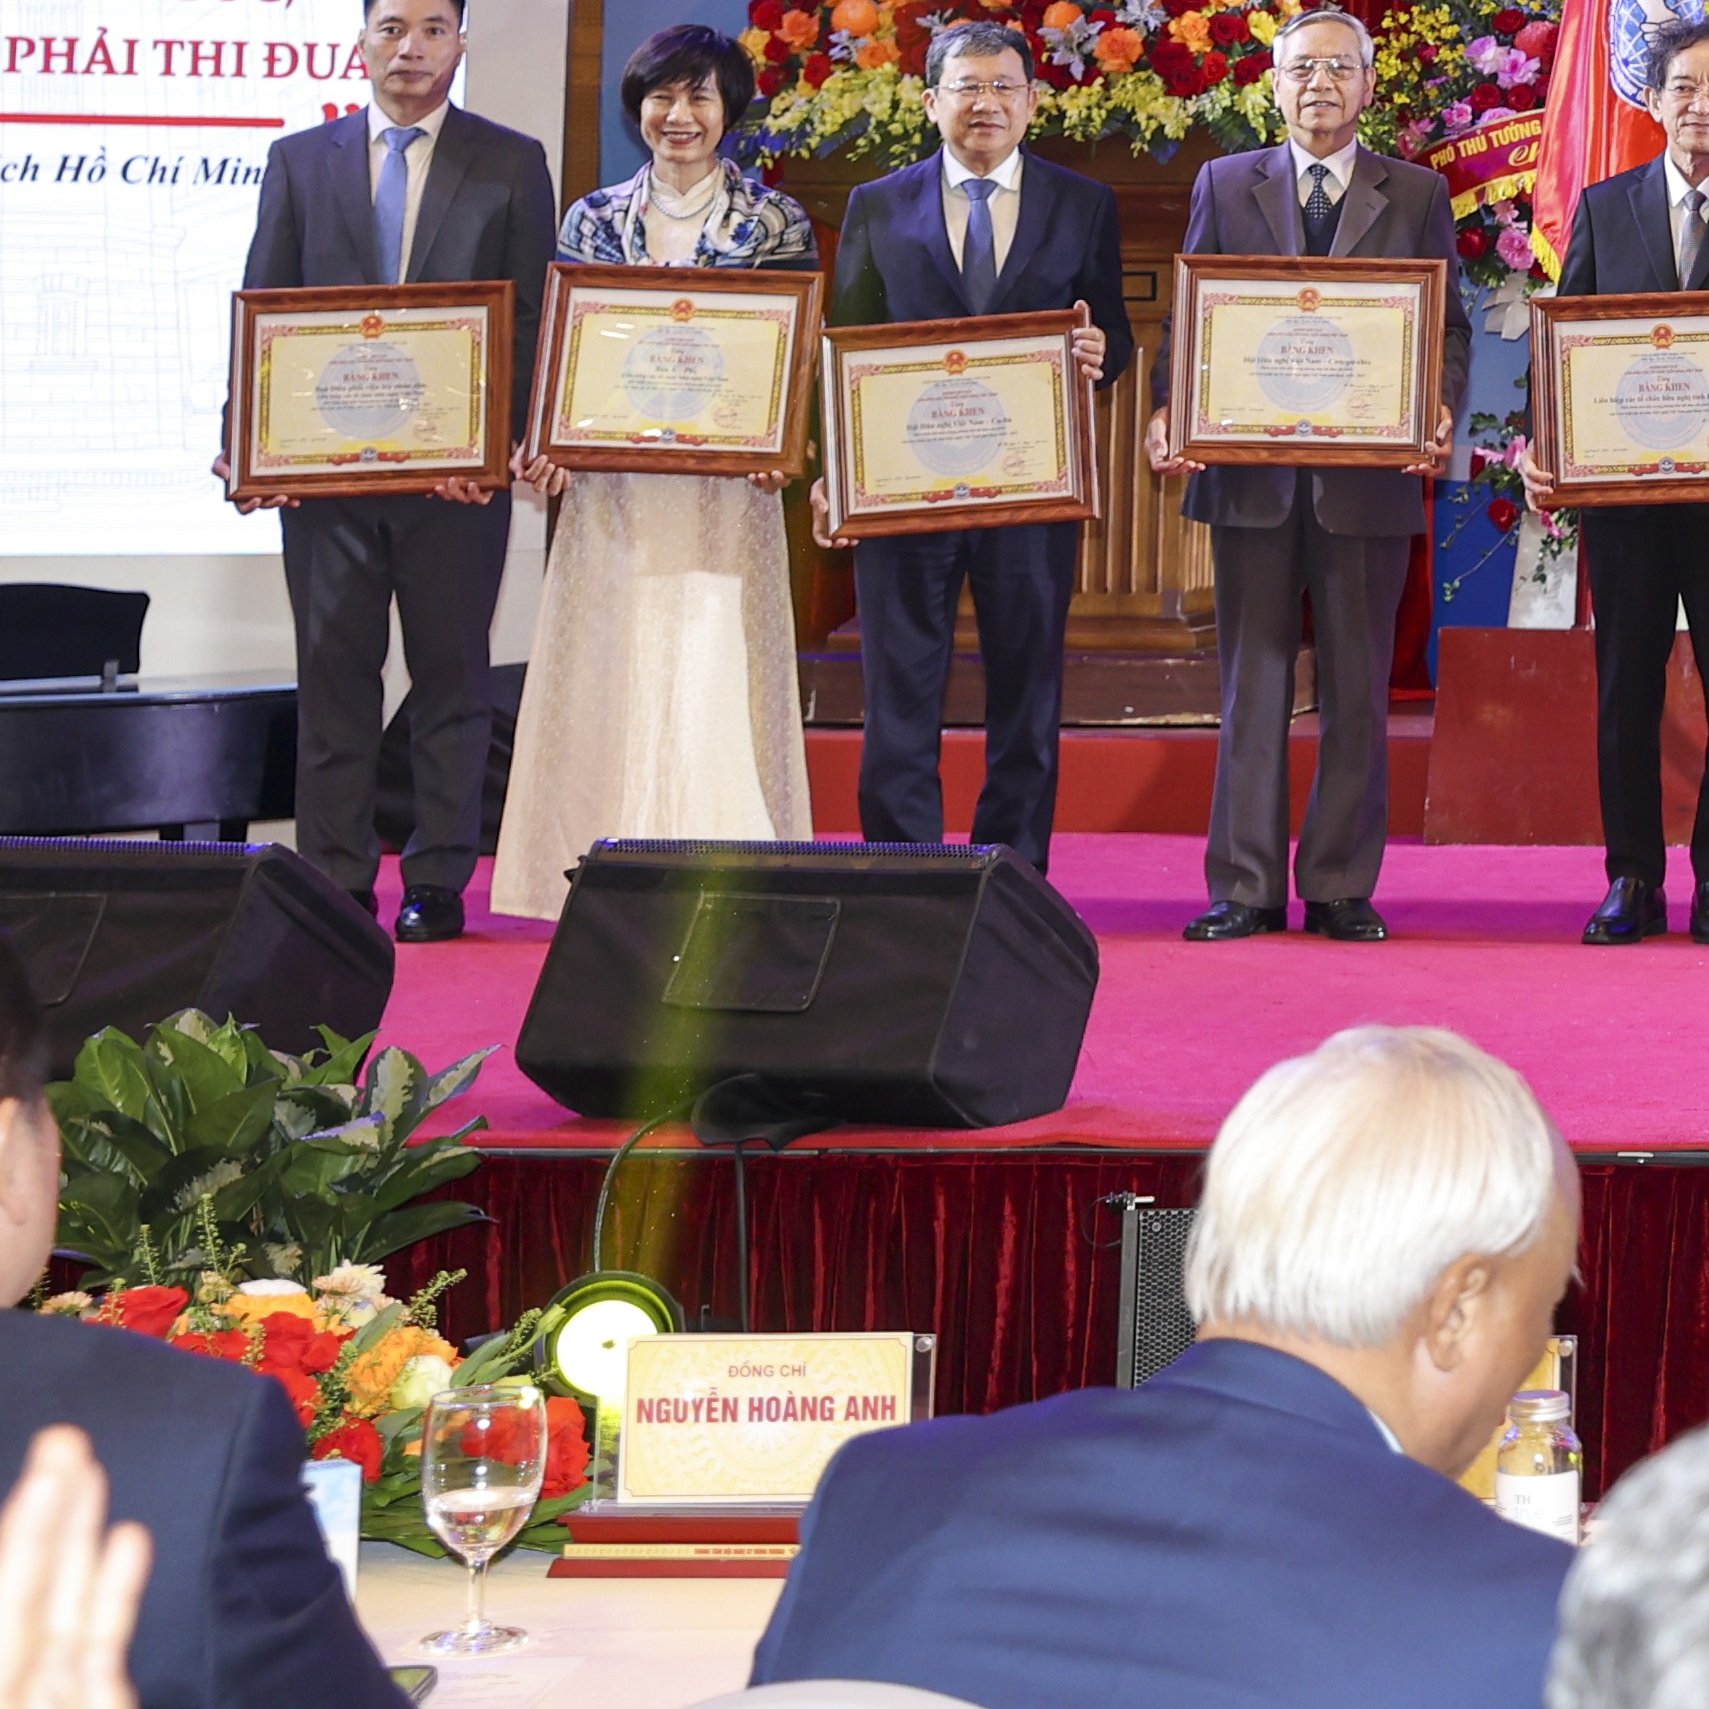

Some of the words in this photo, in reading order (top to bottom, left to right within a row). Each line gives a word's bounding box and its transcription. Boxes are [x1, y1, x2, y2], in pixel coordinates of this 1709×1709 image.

[4, 27, 138, 76] PHẢI
[155, 40, 248, 78] THI
[262, 41, 370, 80] ĐUA
[1429, 148, 1456, 171] PHÓ
[1456, 129, 1489, 158] THỦ
[1489, 118, 1541, 147] TƯỚNG
[55, 147, 106, 183] Hồ
[121, 154, 182, 185] Chí
[193, 156, 263, 185] Min
[1665, 381, 1690, 392] KHEN
[779, 1361, 807, 1377] CHÍ
[636, 1387, 740, 1424] NGUYỄN
[748, 1391, 835, 1423] HOÀNG
[844, 1395, 897, 1421] ANH
[1515, 1495, 1530, 1504] TH
